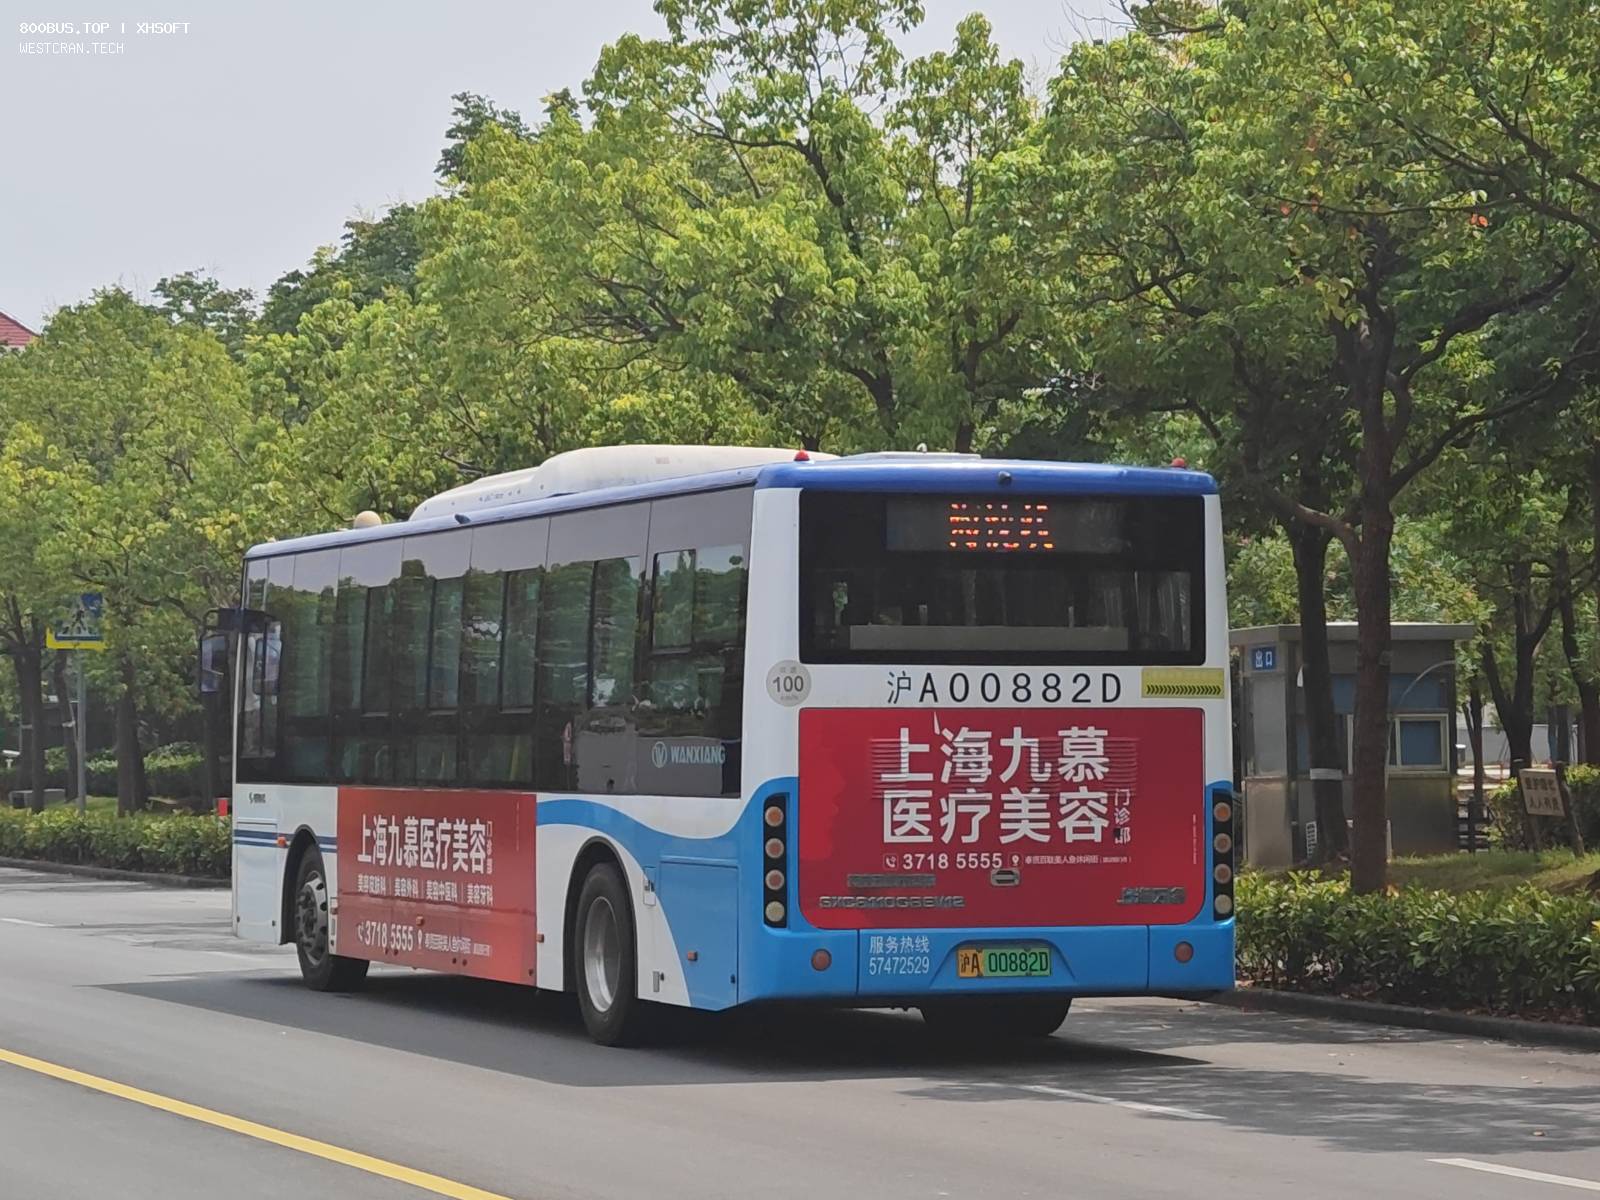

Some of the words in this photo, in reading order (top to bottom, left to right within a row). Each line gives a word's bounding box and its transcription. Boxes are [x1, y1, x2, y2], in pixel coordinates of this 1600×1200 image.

[1255, 649, 1273, 668] 出口
[772, 675, 804, 693] 100
[887, 670, 1121, 704] 沪A00882D
[670, 745, 726, 765] WANXIANG
[881, 726, 1109, 784] 上海九慕
[883, 786, 1109, 844] 医疗美容
[357, 813, 486, 875] 上海九慕医疗美容
[902, 853, 949, 870] 3718
[956, 852, 1003, 869] 5555
[365, 920, 388, 948] 3718
[390, 923, 414, 951] 5555
[869, 936, 930, 954] 服务热线
[869, 956, 930, 975] 57472529
[960, 953, 980, 973] 沪A
[988, 952, 1049, 973] 00882D
